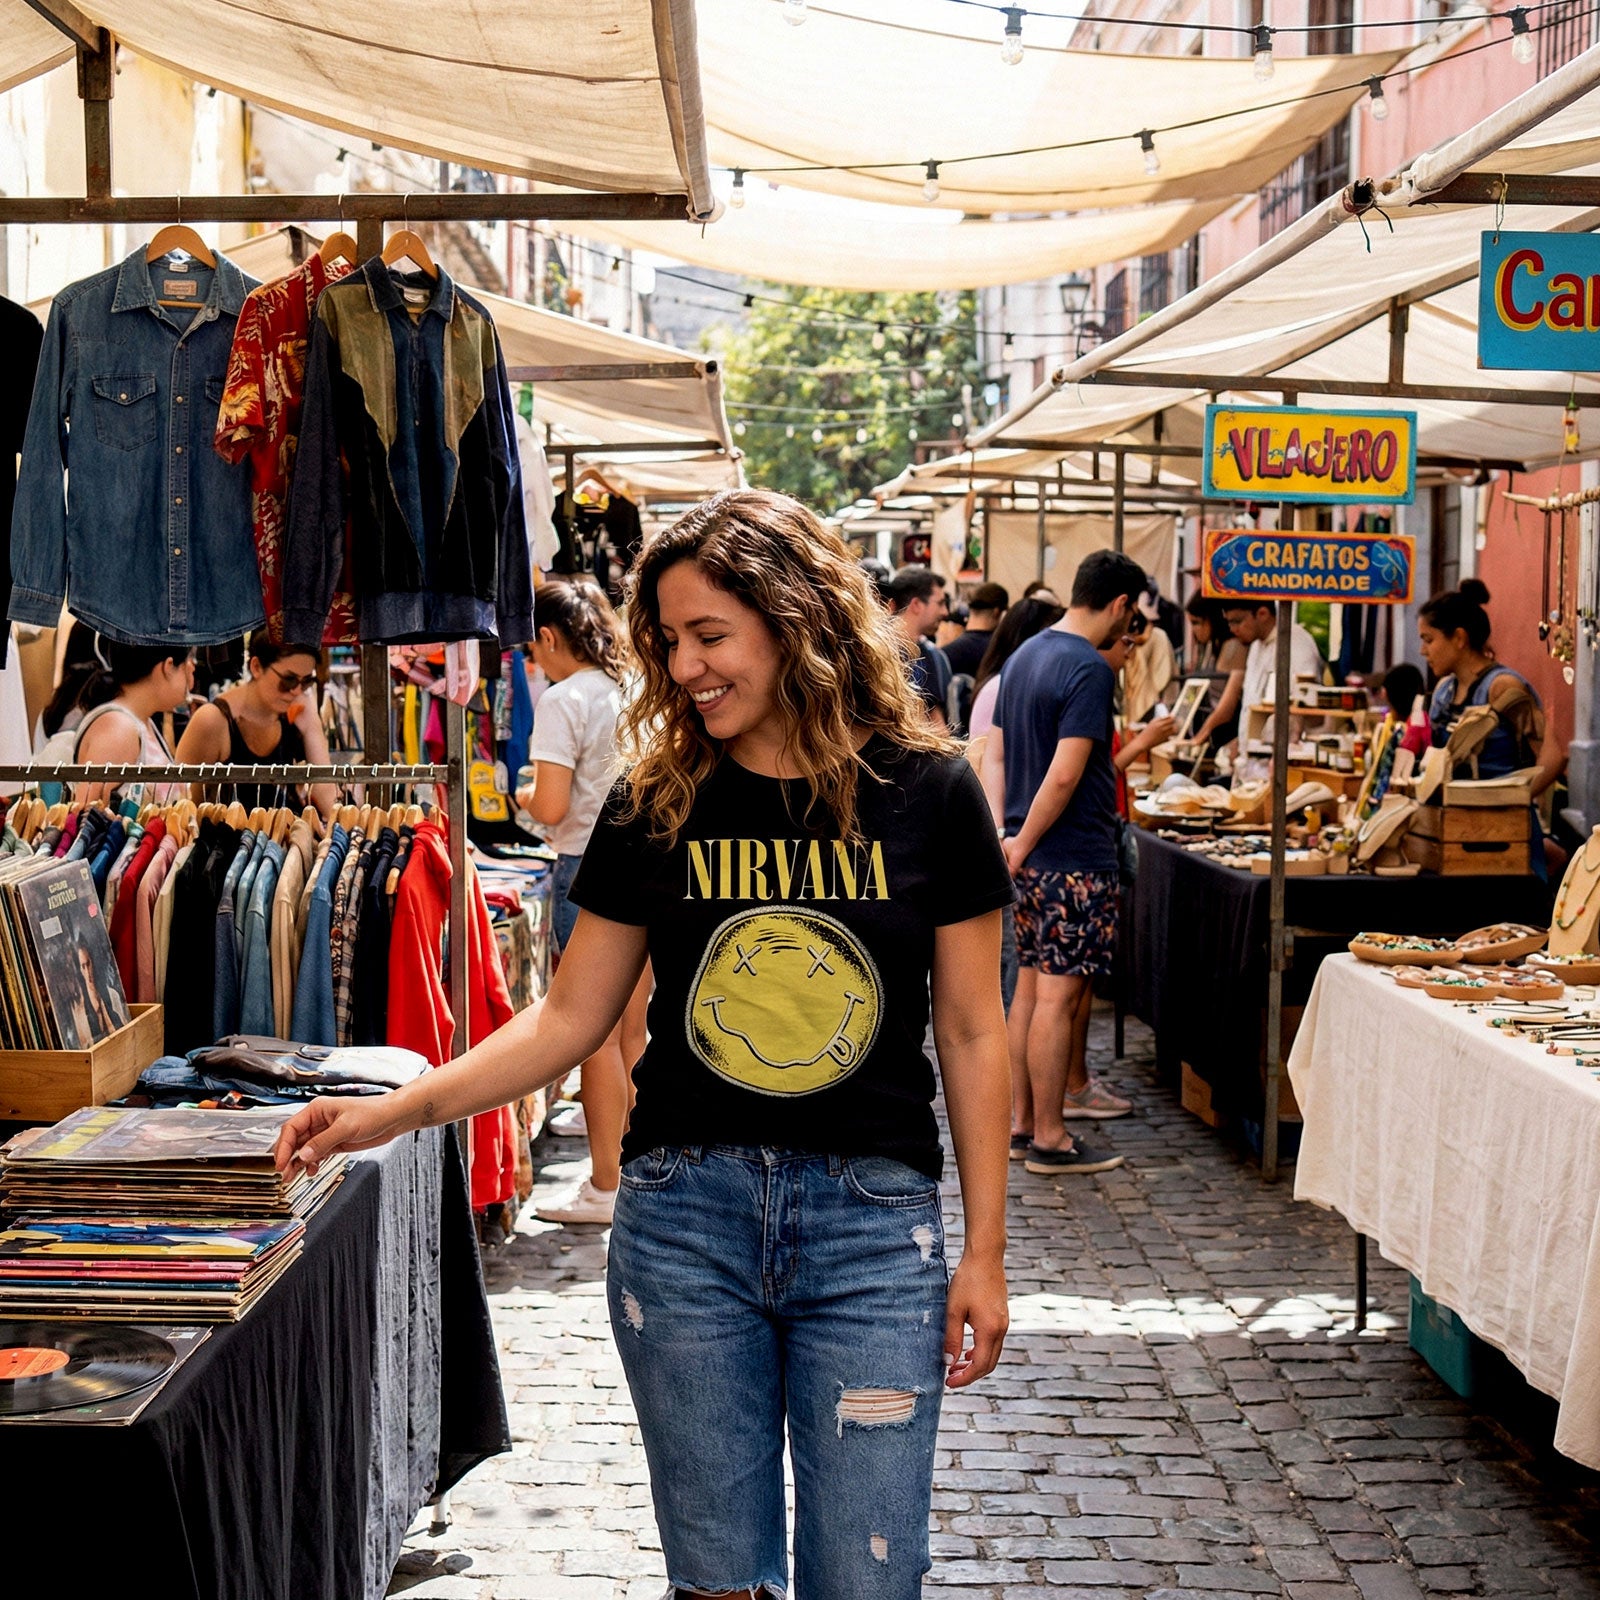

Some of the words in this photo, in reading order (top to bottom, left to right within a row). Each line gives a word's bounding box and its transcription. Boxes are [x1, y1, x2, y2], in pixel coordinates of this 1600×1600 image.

[1246, 541, 1370, 571] CRAFATOS
[1242, 573, 1370, 591] HANDMADE
[683, 838, 892, 900] NIRVANA
